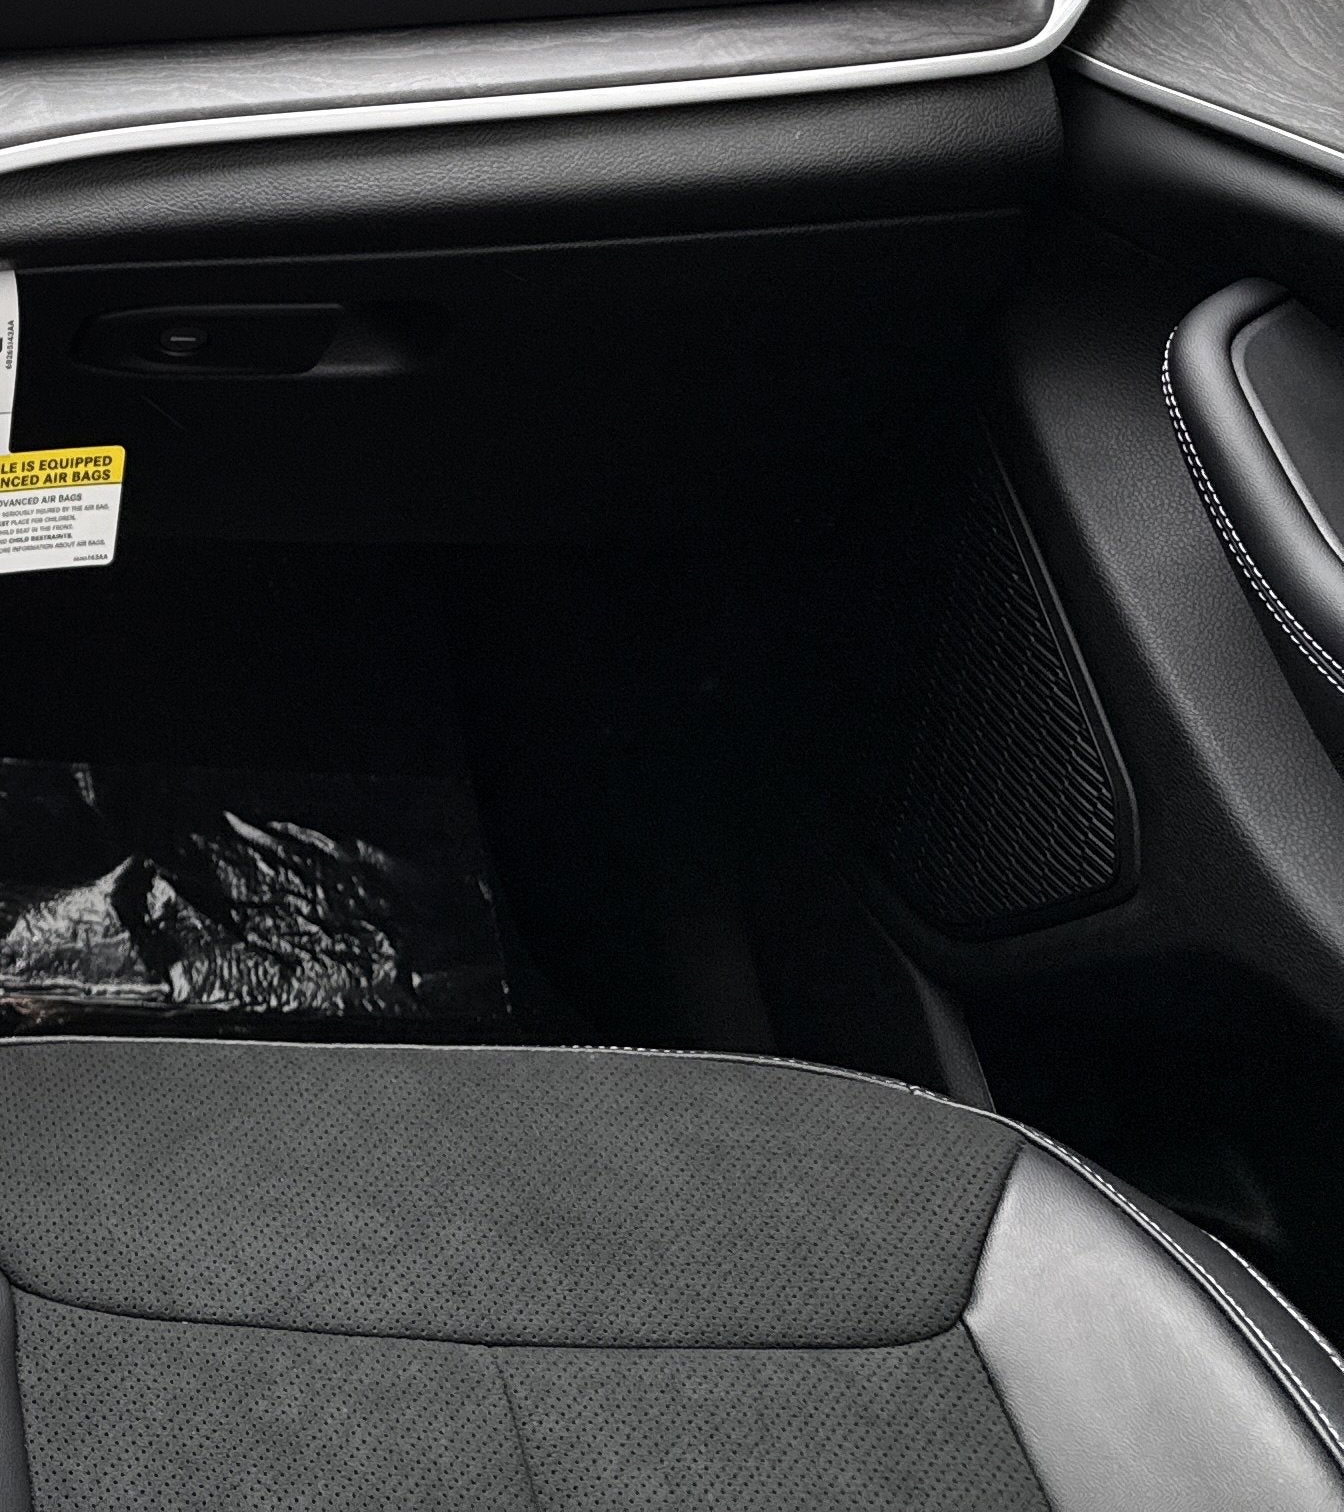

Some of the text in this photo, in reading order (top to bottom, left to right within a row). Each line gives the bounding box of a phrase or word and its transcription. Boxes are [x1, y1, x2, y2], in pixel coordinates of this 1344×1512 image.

[21, 461, 35, 472] IS
[38, 455, 112, 472] EQUIPPED
[43, 472, 68, 485] AIR
[72, 469, 110, 482] BAGS
[41, 495, 56, 504] AIR
[59, 494, 81, 502] BAGS
